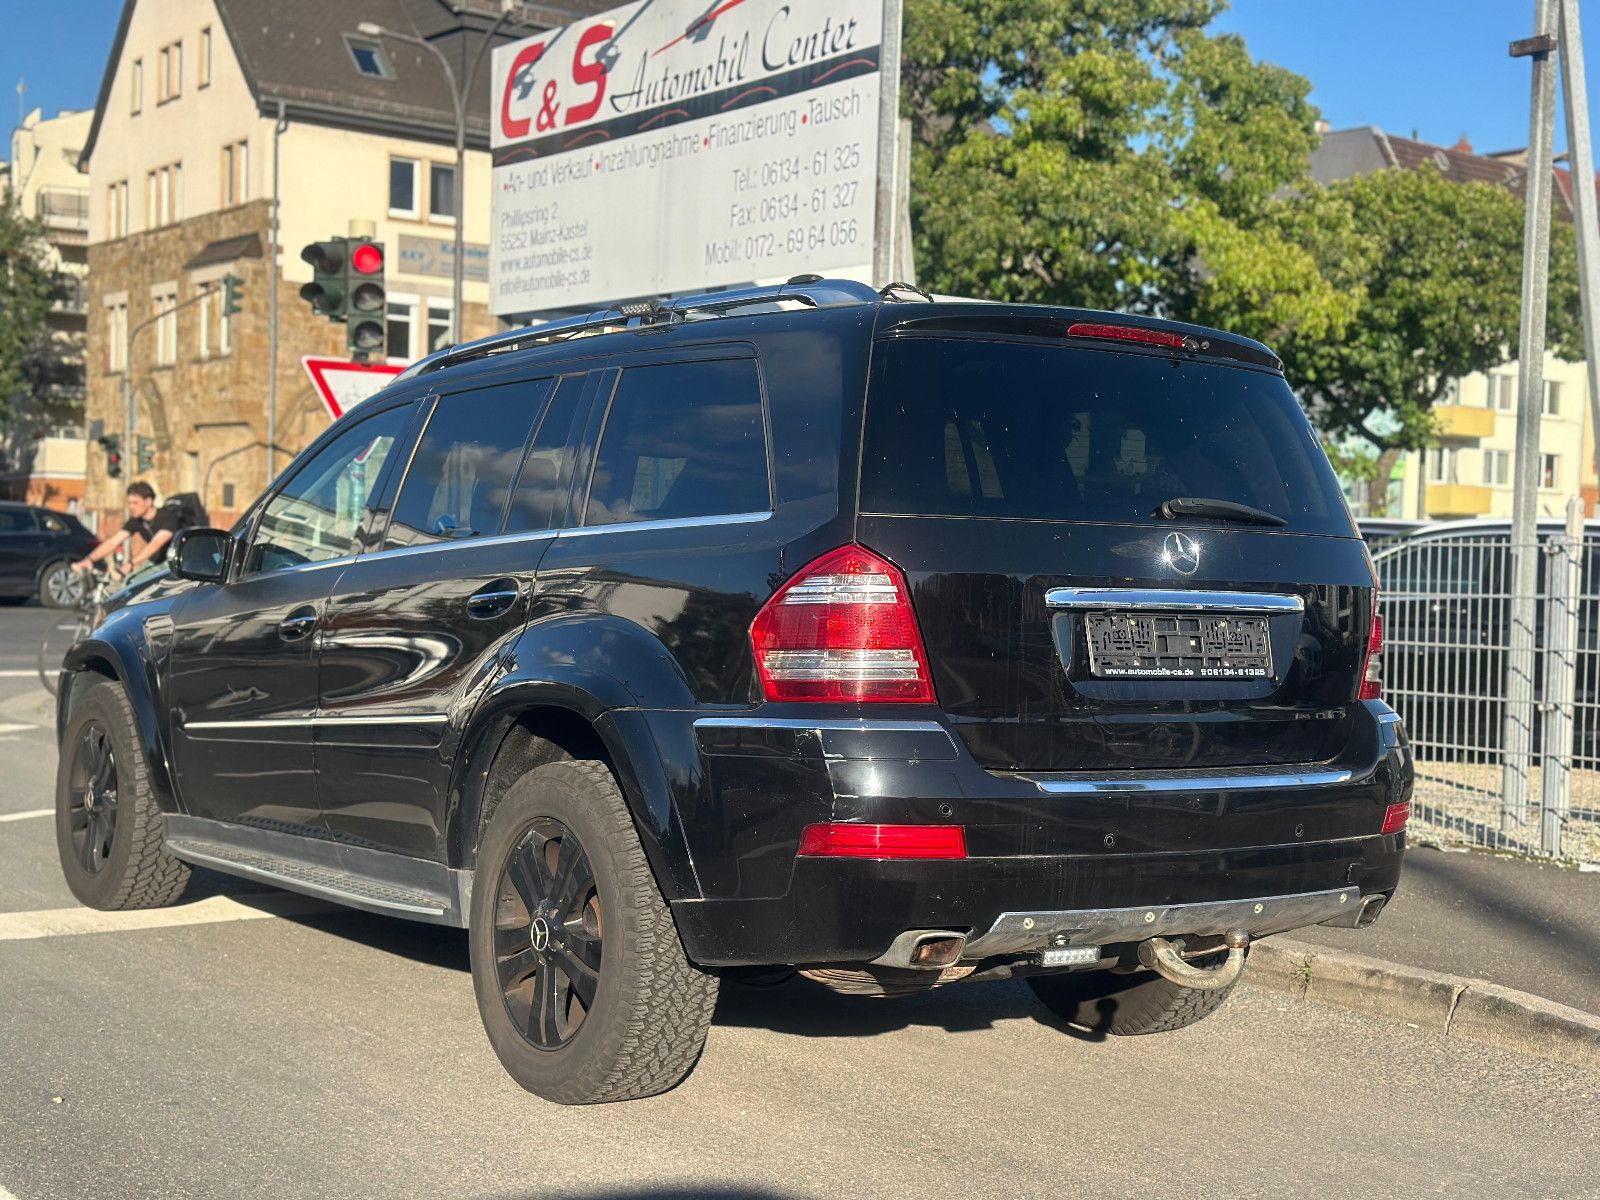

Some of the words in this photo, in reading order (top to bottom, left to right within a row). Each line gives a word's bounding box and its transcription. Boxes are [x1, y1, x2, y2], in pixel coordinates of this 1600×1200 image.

[610, 30, 749, 113] Automobil
[761, 5, 858, 72] Center
[528, 166, 548, 190] und
[551, 153, 594, 185] Verkauf
[708, 109, 797, 150] Finanzierung
[808, 88, 860, 126] Tausch
[733, 167, 757, 192] Tel.:
[761, 156, 799, 186] 06134
[813, 150, 827, 176] 61
[833, 143, 860, 171] 325
[551, 202, 558, 220] 2
[730, 204, 756, 228] Fax:
[760, 192, 798, 223] 06134
[812, 187, 826, 213] 61
[833, 181, 858, 209] 327
[705, 237, 741, 266] Mobil:
[745, 232, 775, 260] 0172
[787, 227, 804, 253] 69
[808, 224, 825, 250] 64
[830, 219, 857, 247] 056
